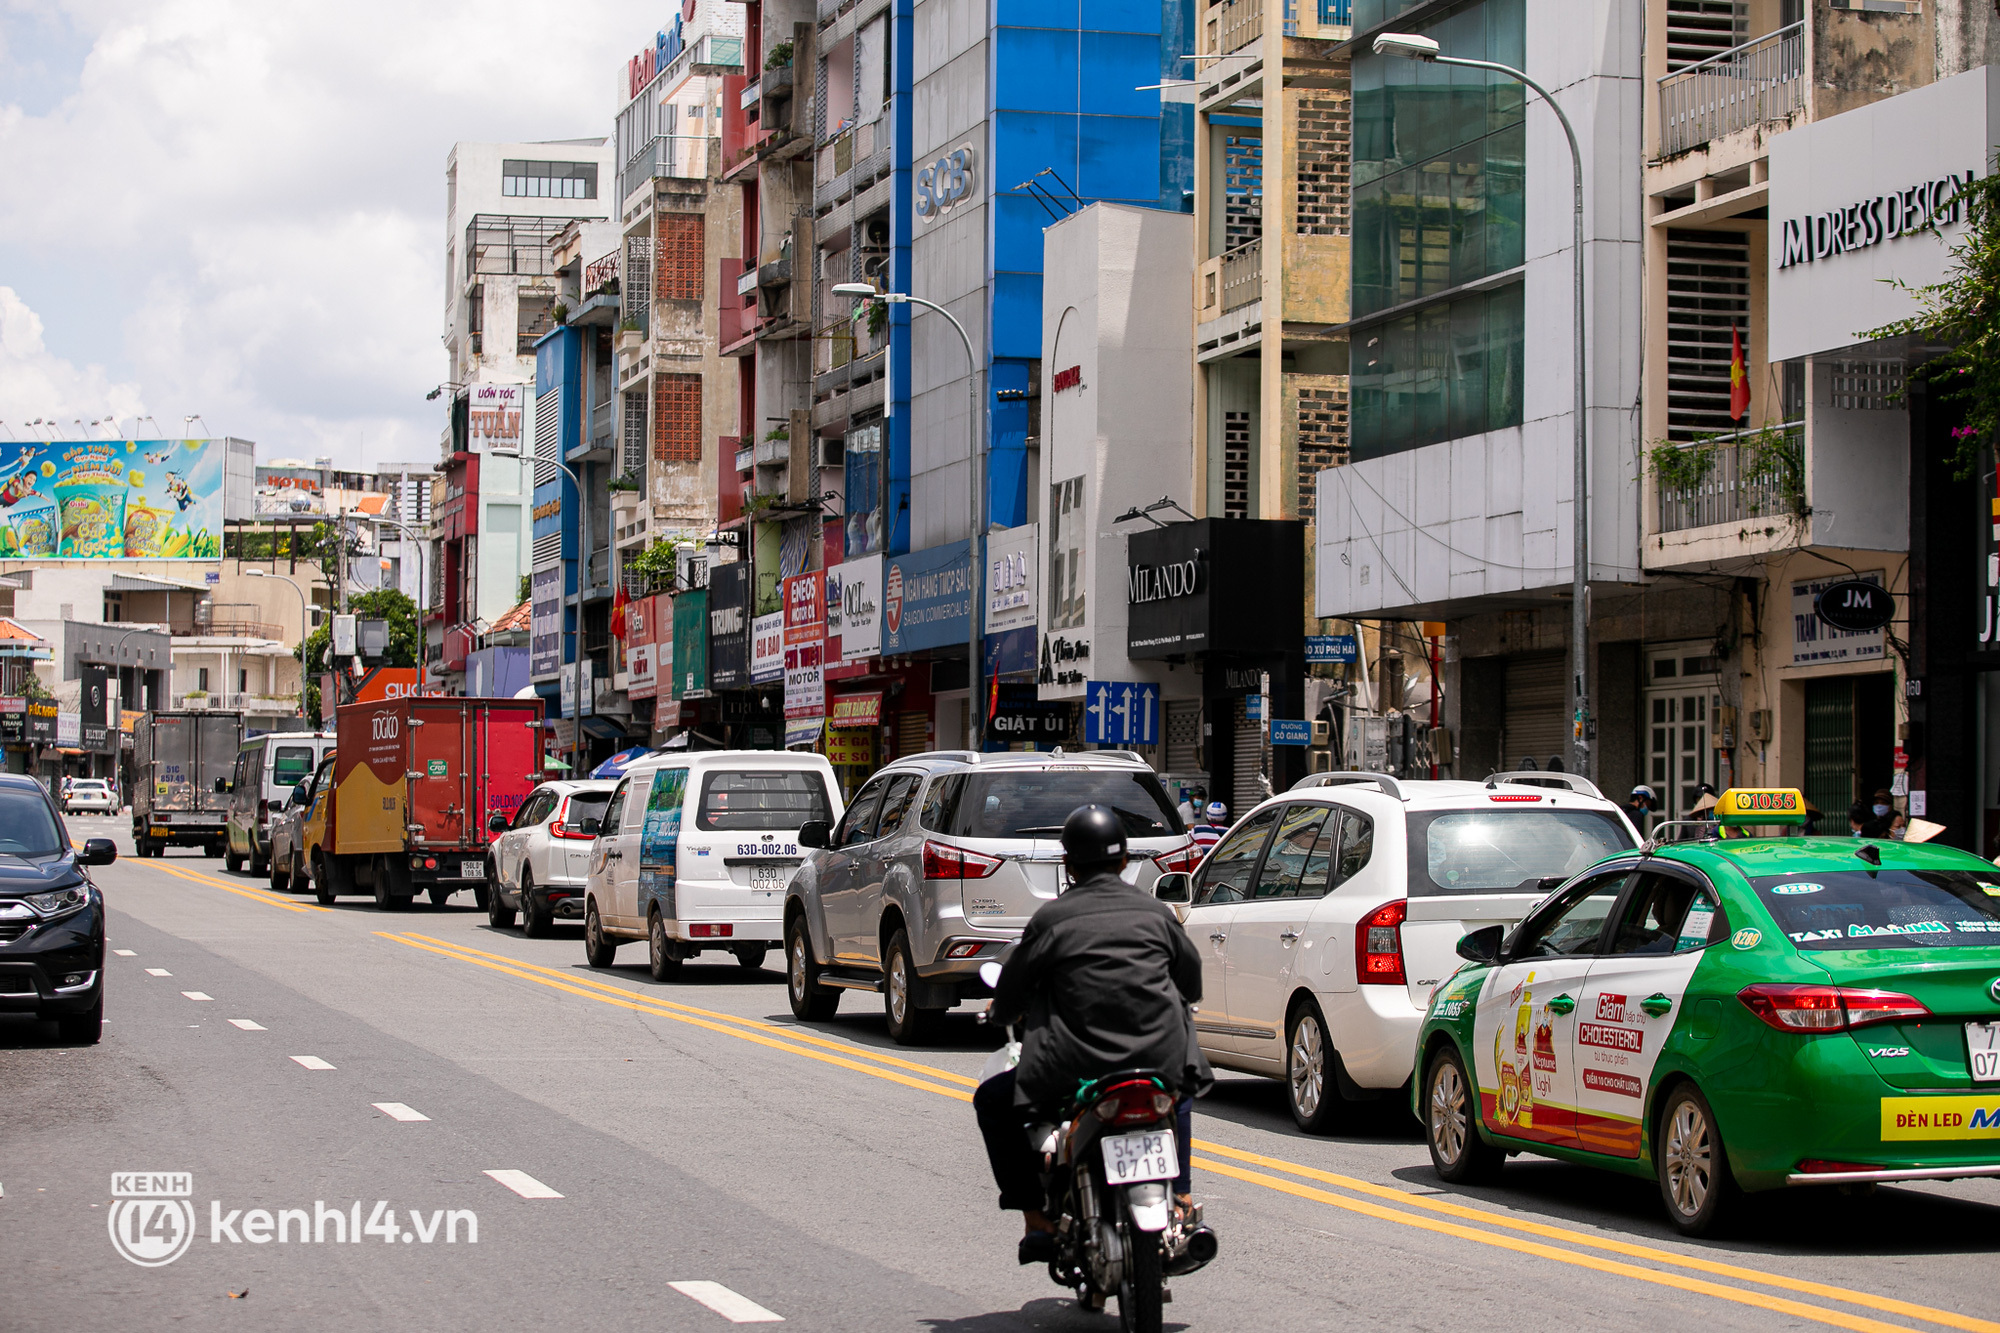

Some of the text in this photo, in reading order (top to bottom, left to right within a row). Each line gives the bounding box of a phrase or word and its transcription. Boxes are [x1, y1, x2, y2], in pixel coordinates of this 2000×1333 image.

[916, 149, 968, 217] SCB
[1815, 196, 1882, 260] DRESS
[1886, 169, 1974, 240] DESIGN
[478, 387, 515, 399] UỐN TÓC
[103, 463, 122, 477] VUI
[268, 475, 319, 491] HOTEL
[69, 510, 114, 526] Snack
[791, 576, 817, 604] ENEOS
[905, 561, 967, 603] NGÂN HÀNG TMCP SÀI
[1128, 560, 1197, 605] MILANDO
[1842, 589, 1872, 609] JM
[791, 604, 816, 622] MOTOR OIL
[904, 608, 923, 627] SAIGON
[926, 601, 963, 623] COMMERCIAL
[711, 607, 744, 637] TRUNG
[756, 637, 767, 660] GIA
[768, 631, 780, 656] BẢO
[1326, 643, 1341, 655] PHÚ
[789, 671, 820, 686] MOTOR
[1906, 680, 1922, 696] 160
[994, 713, 1064, 735] GIẶT ỦI
[1281, 722, 1303, 732] ĐƯỜNG
[829, 737, 872, 747] XE GA
[1286, 732, 1308, 742] GIANG
[829, 752, 846, 762] XE
[166, 765, 180, 773] 51C
[160, 774, 185, 783] 857.49
[1752, 793, 1796, 810] 1055
[737, 843, 797, 856] 63D-002.06
[758, 868, 777, 878] 63D
[1734, 931, 1759, 946] 8289
[1788, 929, 1843, 944] TAXI
[1597, 994, 1625, 1021] Giảm
[1625, 1009, 1636, 1026] hấp
[1581, 1025, 1641, 1050] CHOLESTEROL
[1868, 1047, 1909, 1058] VIOS
[1533, 1053, 1556, 1070] Neptune
[1535, 1072, 1552, 1096] Light
[1586, 1071, 1640, 1093] ĐIỂM 10 CHO CHẤT LƯỢNG
[1896, 1109, 1928, 1128] ĐÈN
[1933, 1113, 1962, 1128] LED
[1113, 1136, 1164, 1158] 54-R3
[1117, 1157, 1168, 1179] 0718
